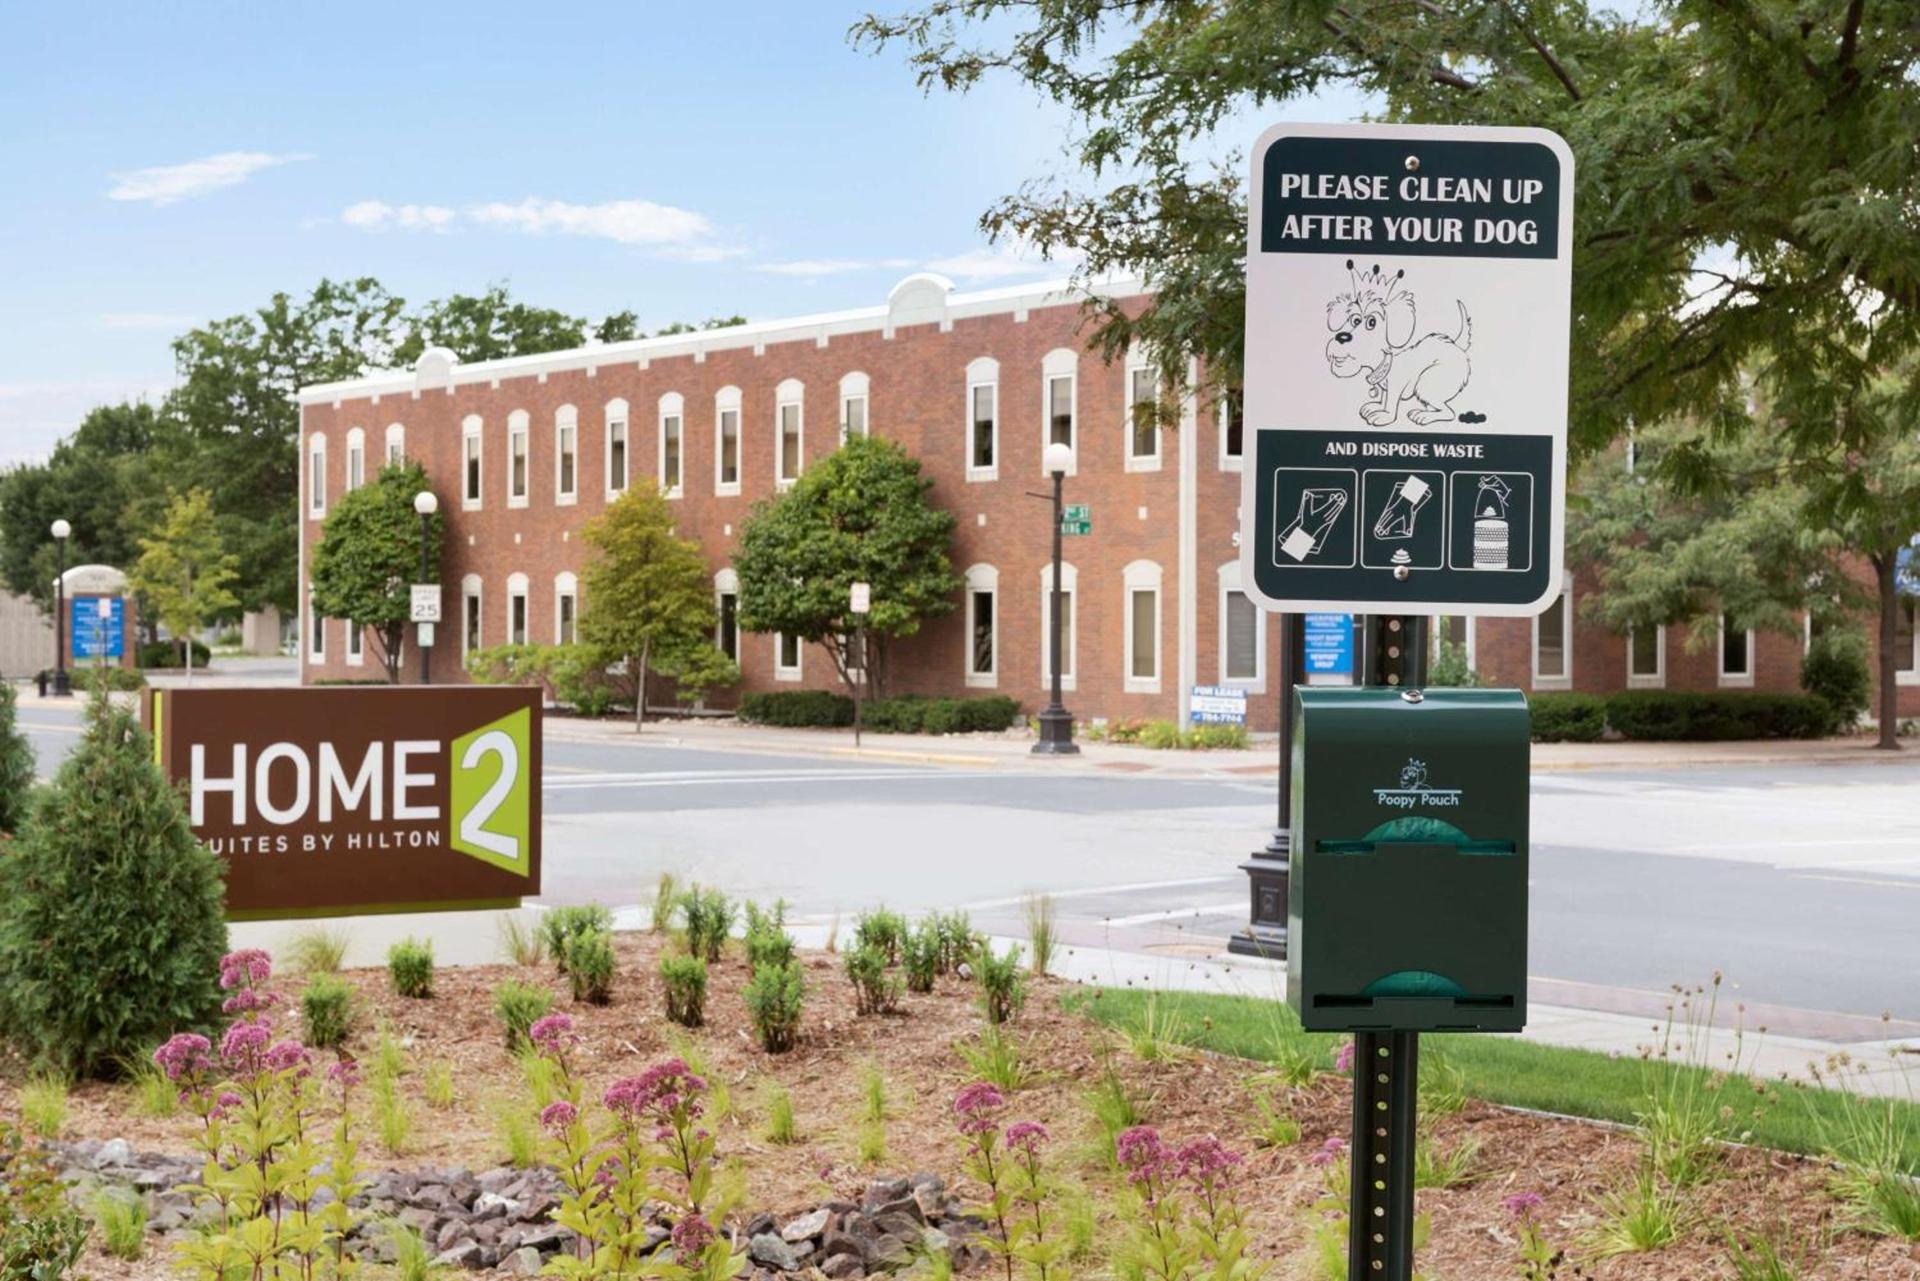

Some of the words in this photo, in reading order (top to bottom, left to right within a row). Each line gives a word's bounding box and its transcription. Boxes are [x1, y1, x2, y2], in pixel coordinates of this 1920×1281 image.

[1281, 173, 1389, 200] PLEASE
[1400, 176, 1492, 203] CLEAN
[1503, 179, 1543, 204] UP
[1281, 214, 1373, 241] AFTER
[1383, 216, 1463, 243] YOUR
[1474, 219, 1538, 244] DOG
[1325, 441, 1357, 456] AND
[1362, 442, 1429, 457] DISPOSE
[1433, 444, 1484, 458] WASTE
[415, 604, 437, 617] 25
[1194, 687, 1213, 697] FOR
[1215, 687, 1244, 699] LEASE
[191, 740, 441, 826] HOME
[460, 730, 519, 860] 2
[1378, 793, 1417, 808] Poopy
[1421, 793, 1459, 806] Pouch
[303, 834, 334, 851] BY
[348, 830, 441, 849] HILTON
